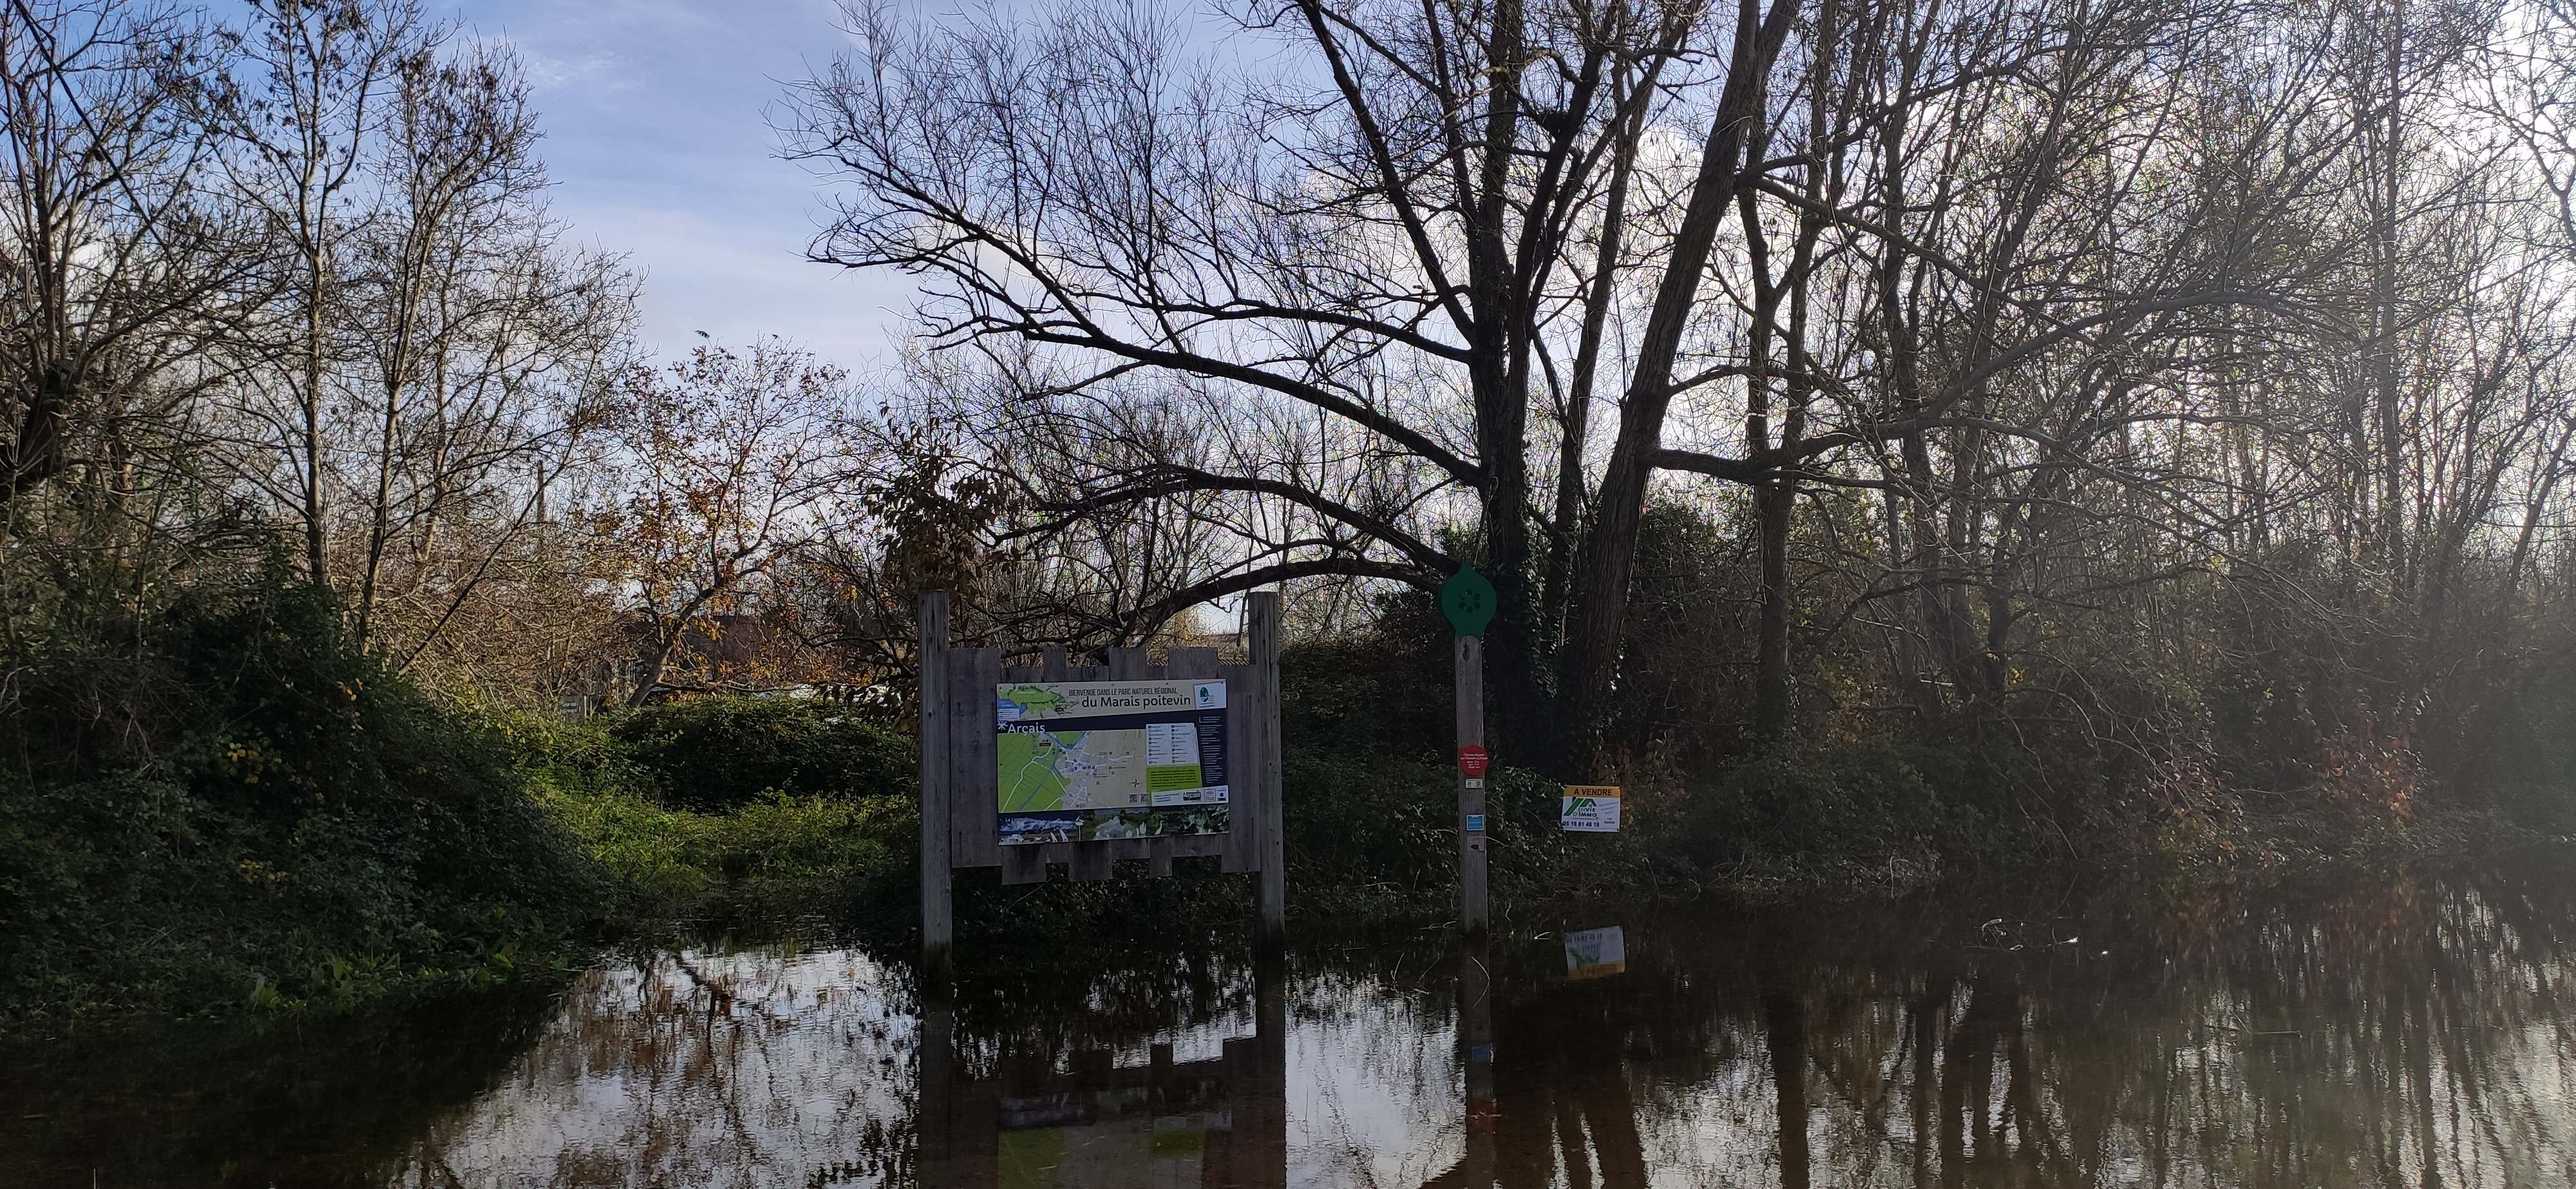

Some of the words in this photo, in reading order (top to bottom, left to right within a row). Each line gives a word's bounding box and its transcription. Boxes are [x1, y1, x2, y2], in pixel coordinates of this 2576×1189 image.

[1082, 696, 1097, 707] du
[1101, 696, 1140, 707] Marais
[1144, 694, 1191, 709] poitevin
[1007, 722, 1045, 736] Arçais
